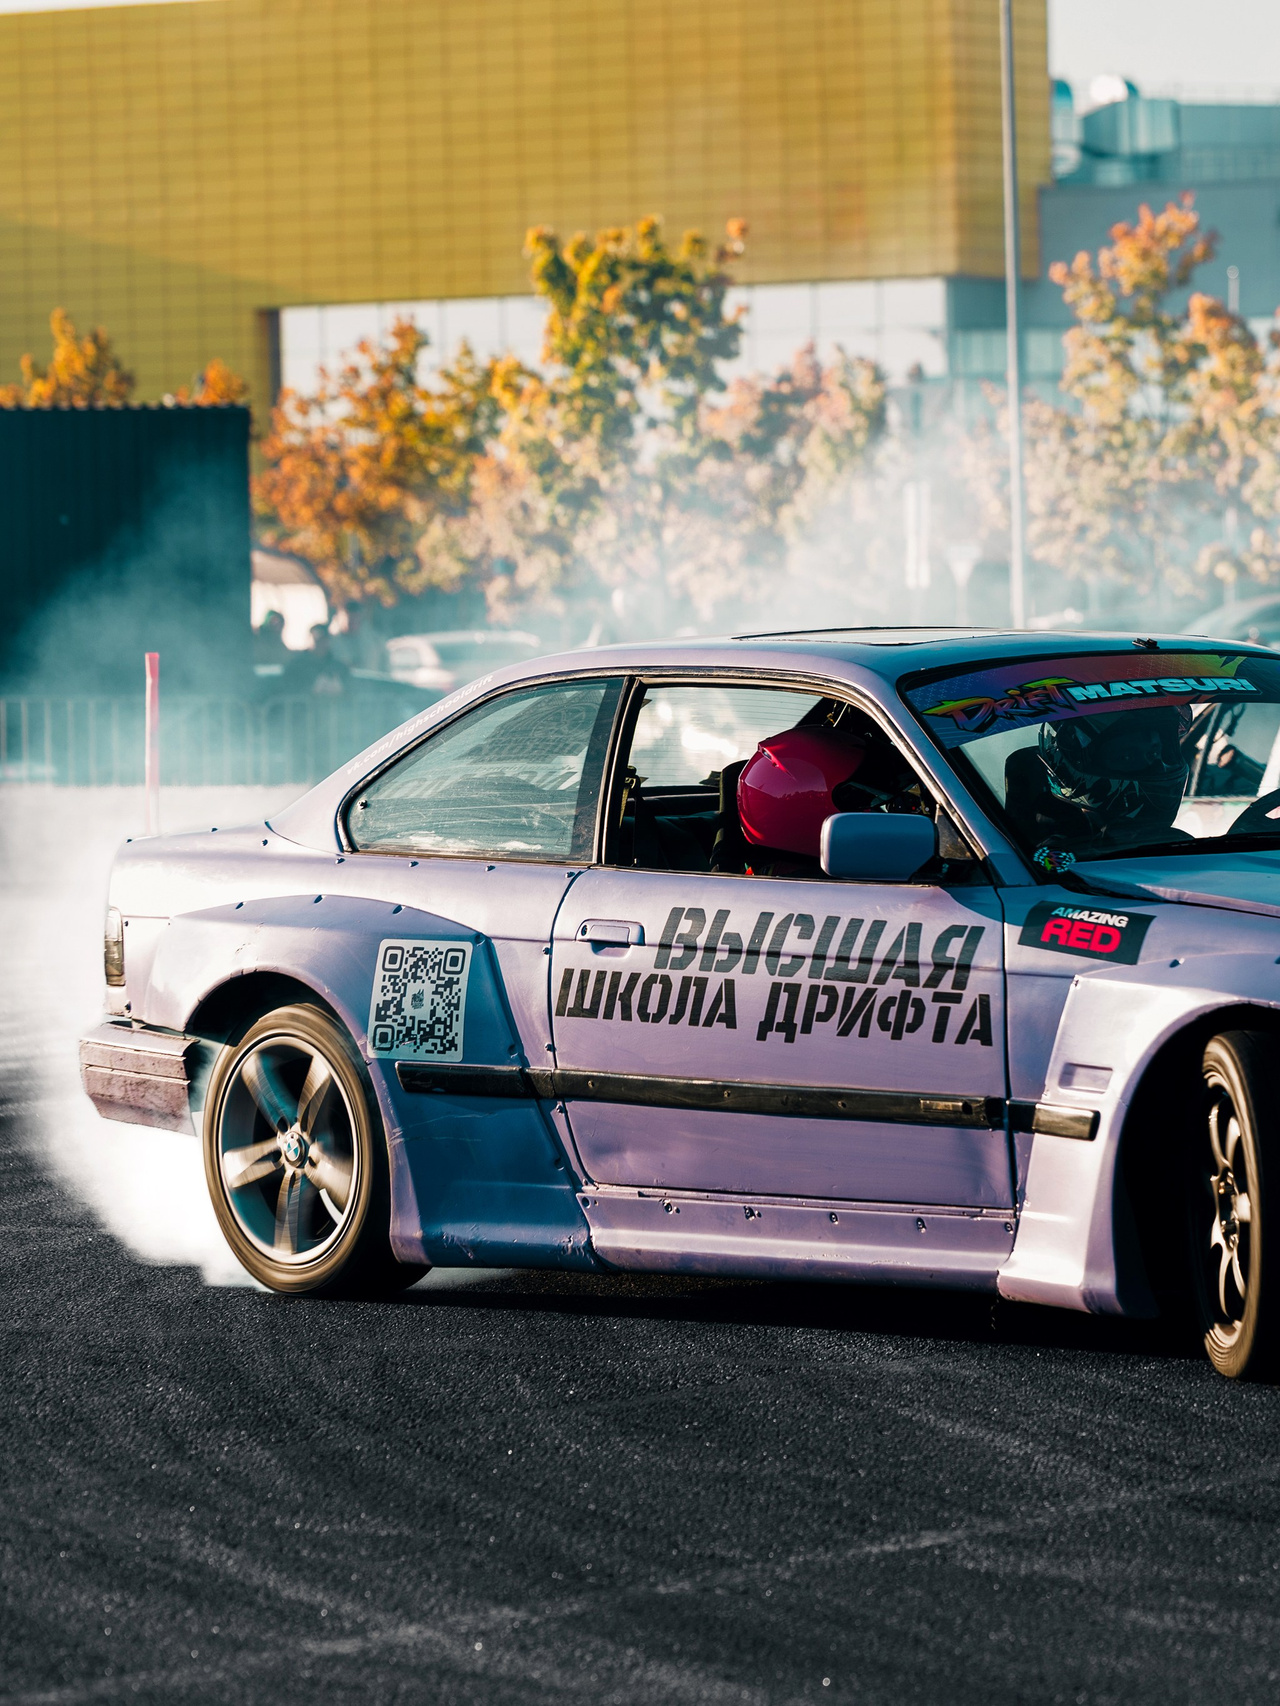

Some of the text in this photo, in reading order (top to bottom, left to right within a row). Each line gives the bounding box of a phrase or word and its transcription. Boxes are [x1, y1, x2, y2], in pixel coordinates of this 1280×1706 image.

[1066, 678, 1257, 702] MATSURI
[347, 675, 494, 775] vk.com/highschooldrift
[1040, 917, 1122, 953] RED
[1052, 907, 1130, 928] AMAZING
[653, 906, 985, 991] ВЫСШАЯ
[554, 968, 994, 1048] ШКОЛА ДРИФТА
